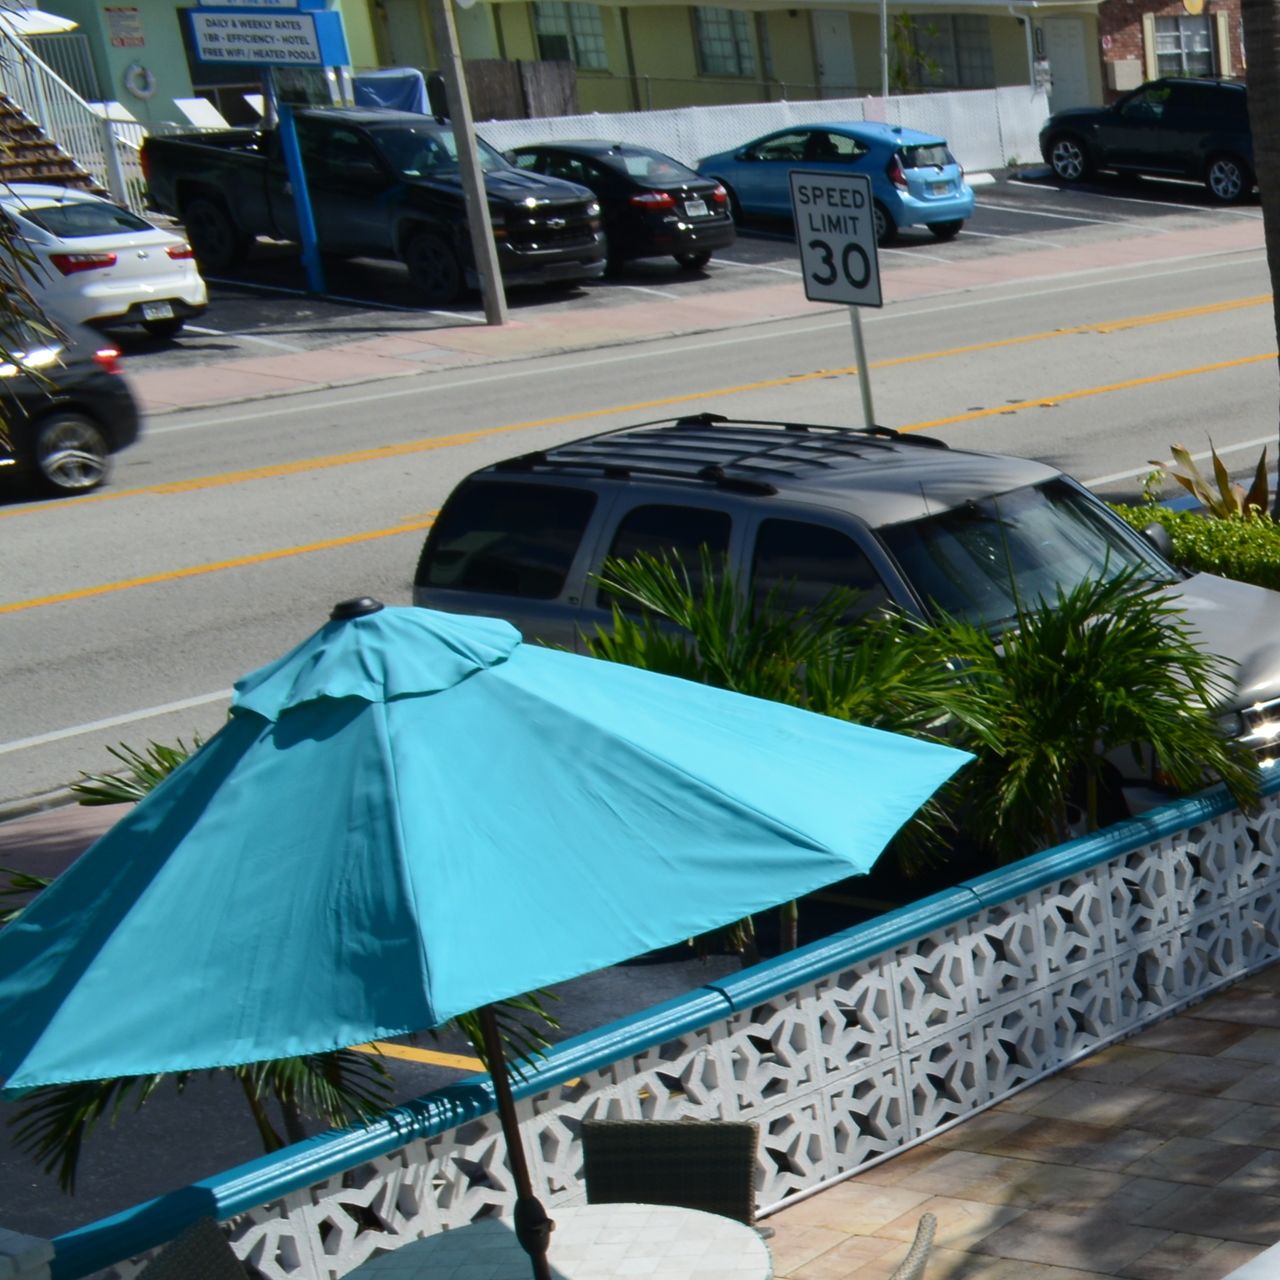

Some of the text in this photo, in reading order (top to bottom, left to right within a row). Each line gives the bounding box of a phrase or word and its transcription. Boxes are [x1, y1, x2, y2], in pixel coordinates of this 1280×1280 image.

[205, 18, 302, 30] DAILY & WEEKLY RATES
[226, 33, 275, 44] EFFICIENCY
[282, 35, 310, 45] HOTEL
[202, 47, 224, 57] FREE
[253, 49, 286, 59] HEATED
[287, 50, 317, 60] POOLS
[798, 185, 865, 209] SPEED
[808, 212, 860, 236] LIMIT
[808, 239, 871, 289] 30
